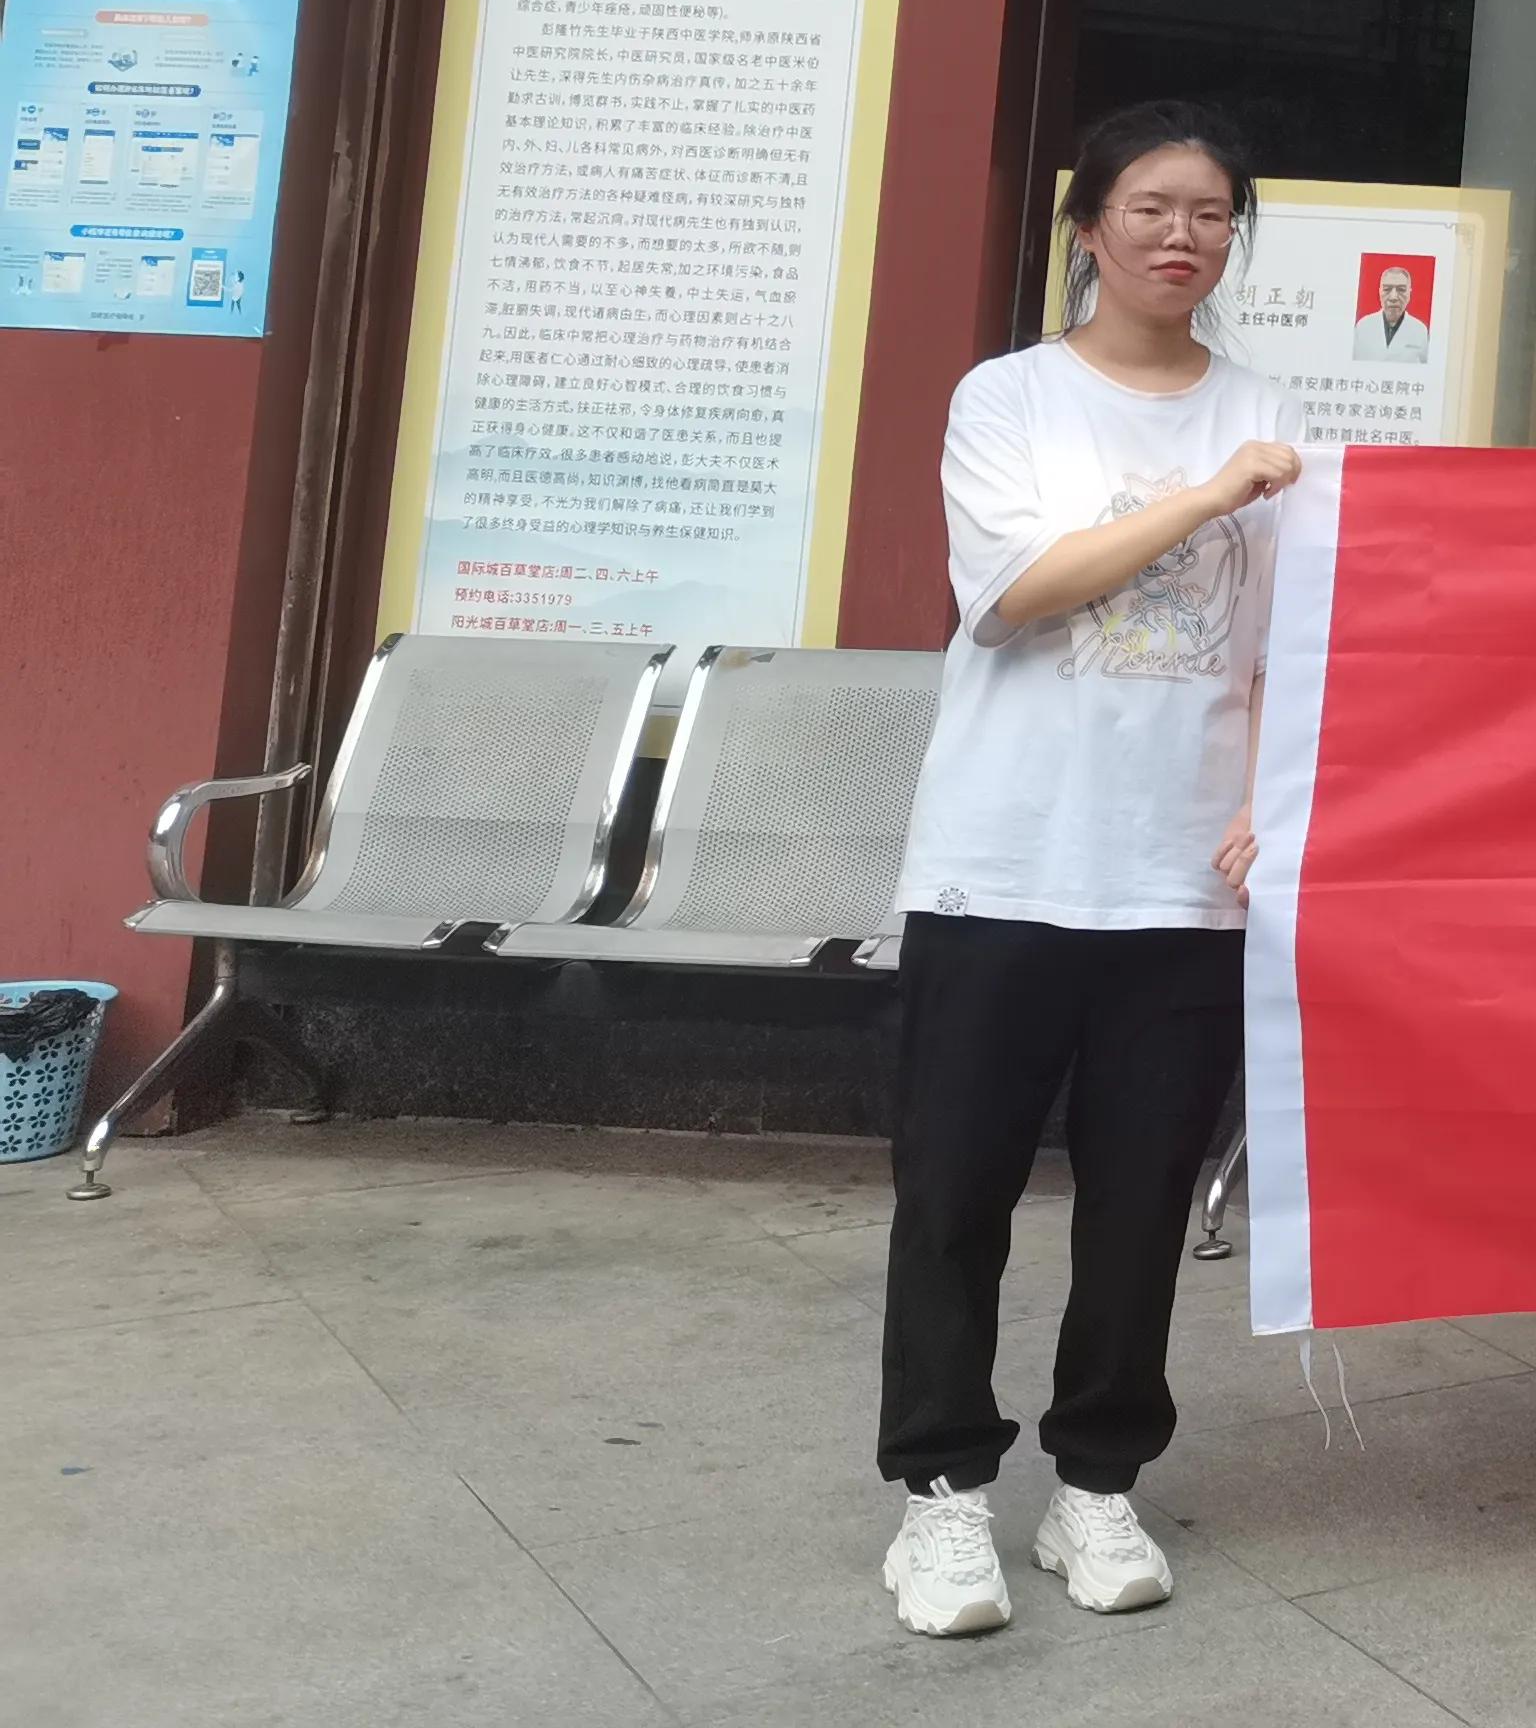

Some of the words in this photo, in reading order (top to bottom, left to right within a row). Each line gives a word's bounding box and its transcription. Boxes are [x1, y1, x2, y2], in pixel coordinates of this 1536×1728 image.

[1238, 313, 1309, 329] 主任中医师
